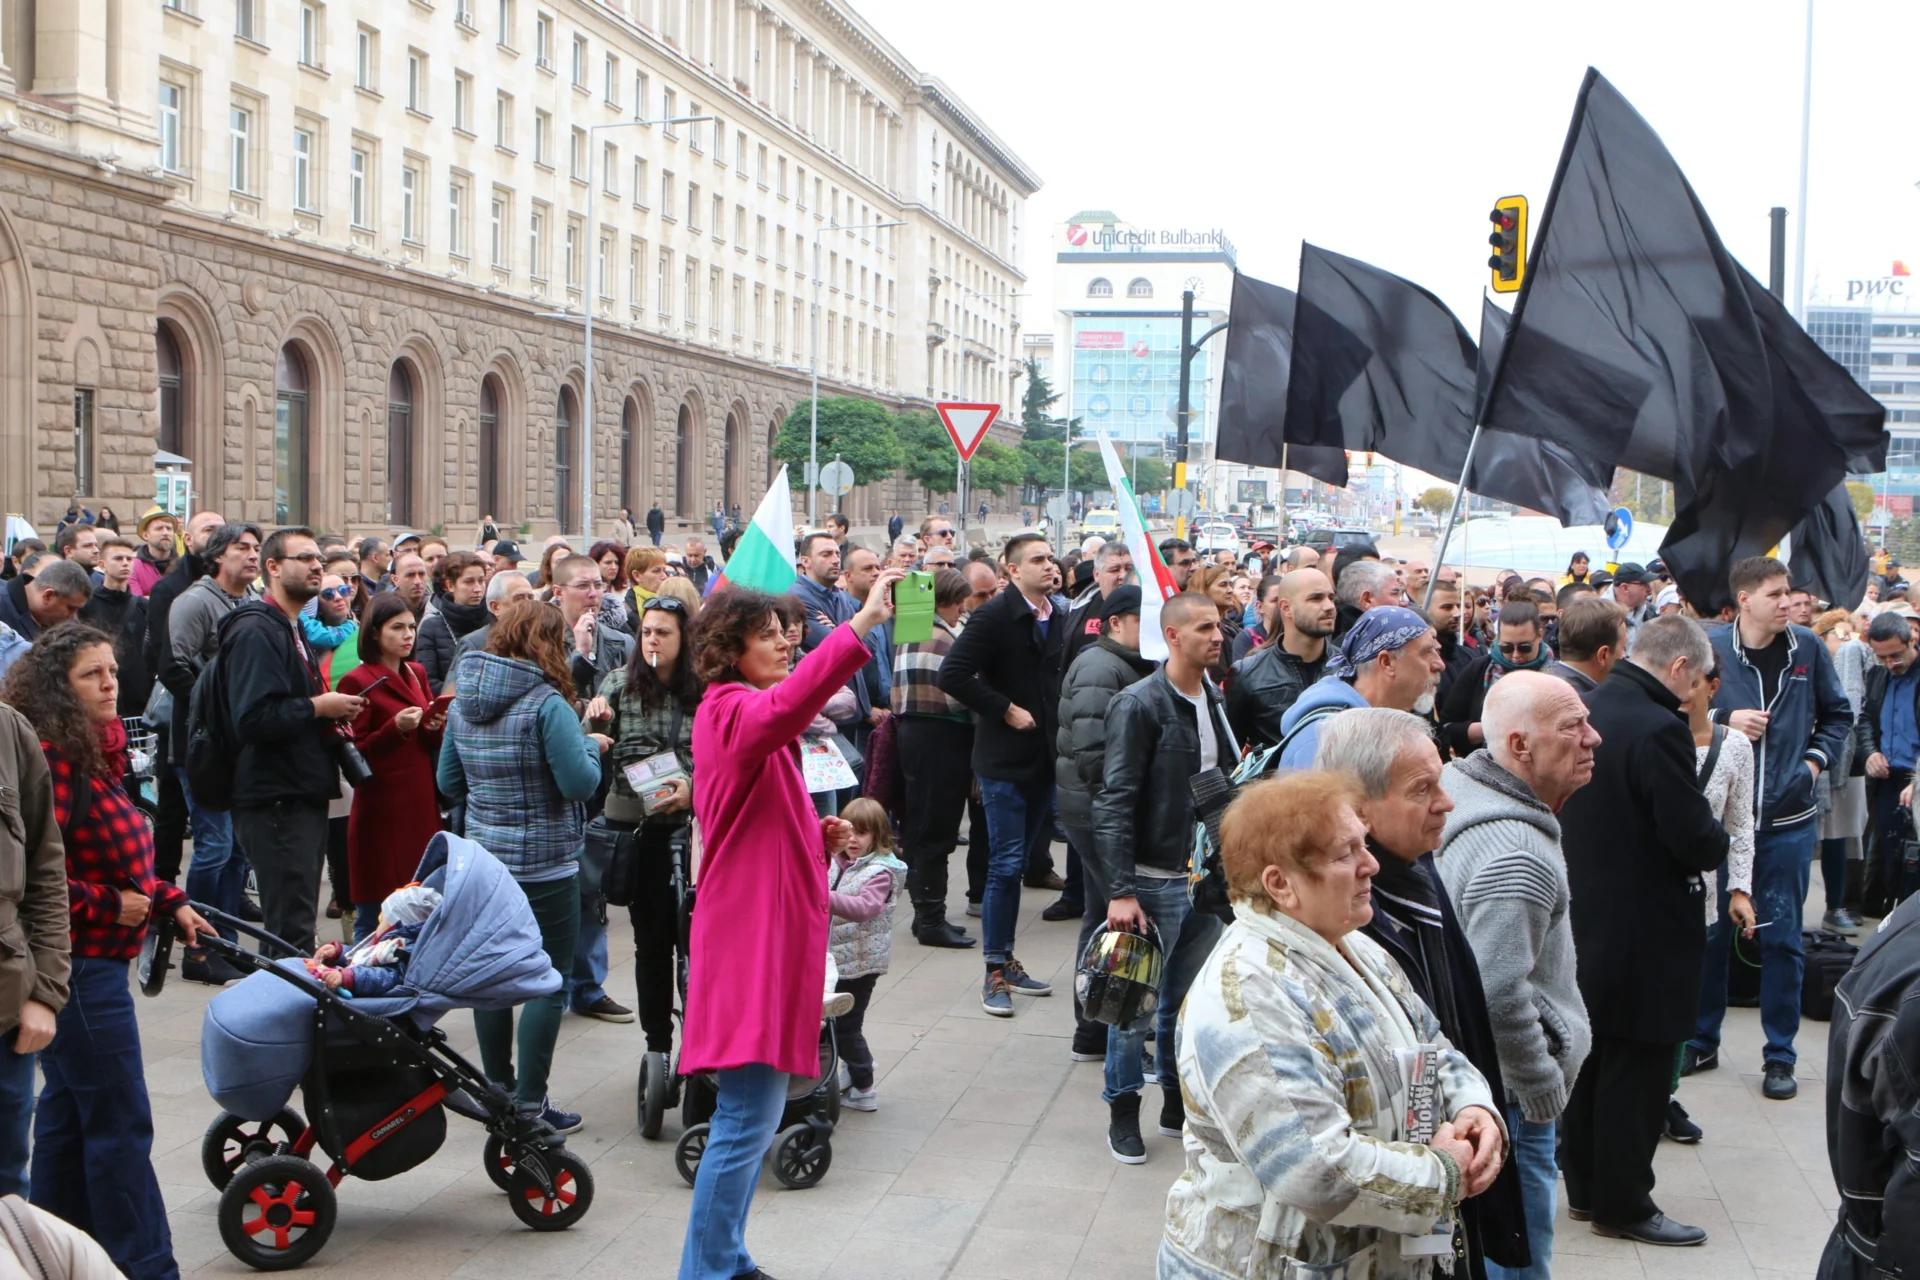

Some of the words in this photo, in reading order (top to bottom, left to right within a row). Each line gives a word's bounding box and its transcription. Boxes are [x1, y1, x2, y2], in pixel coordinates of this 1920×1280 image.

[1092, 229, 1156, 245] UniCredit
[1160, 228, 1220, 245] Bulbank
[1846, 277, 1904, 301] pwc
[371, 1116, 405, 1140] CAMAREL
